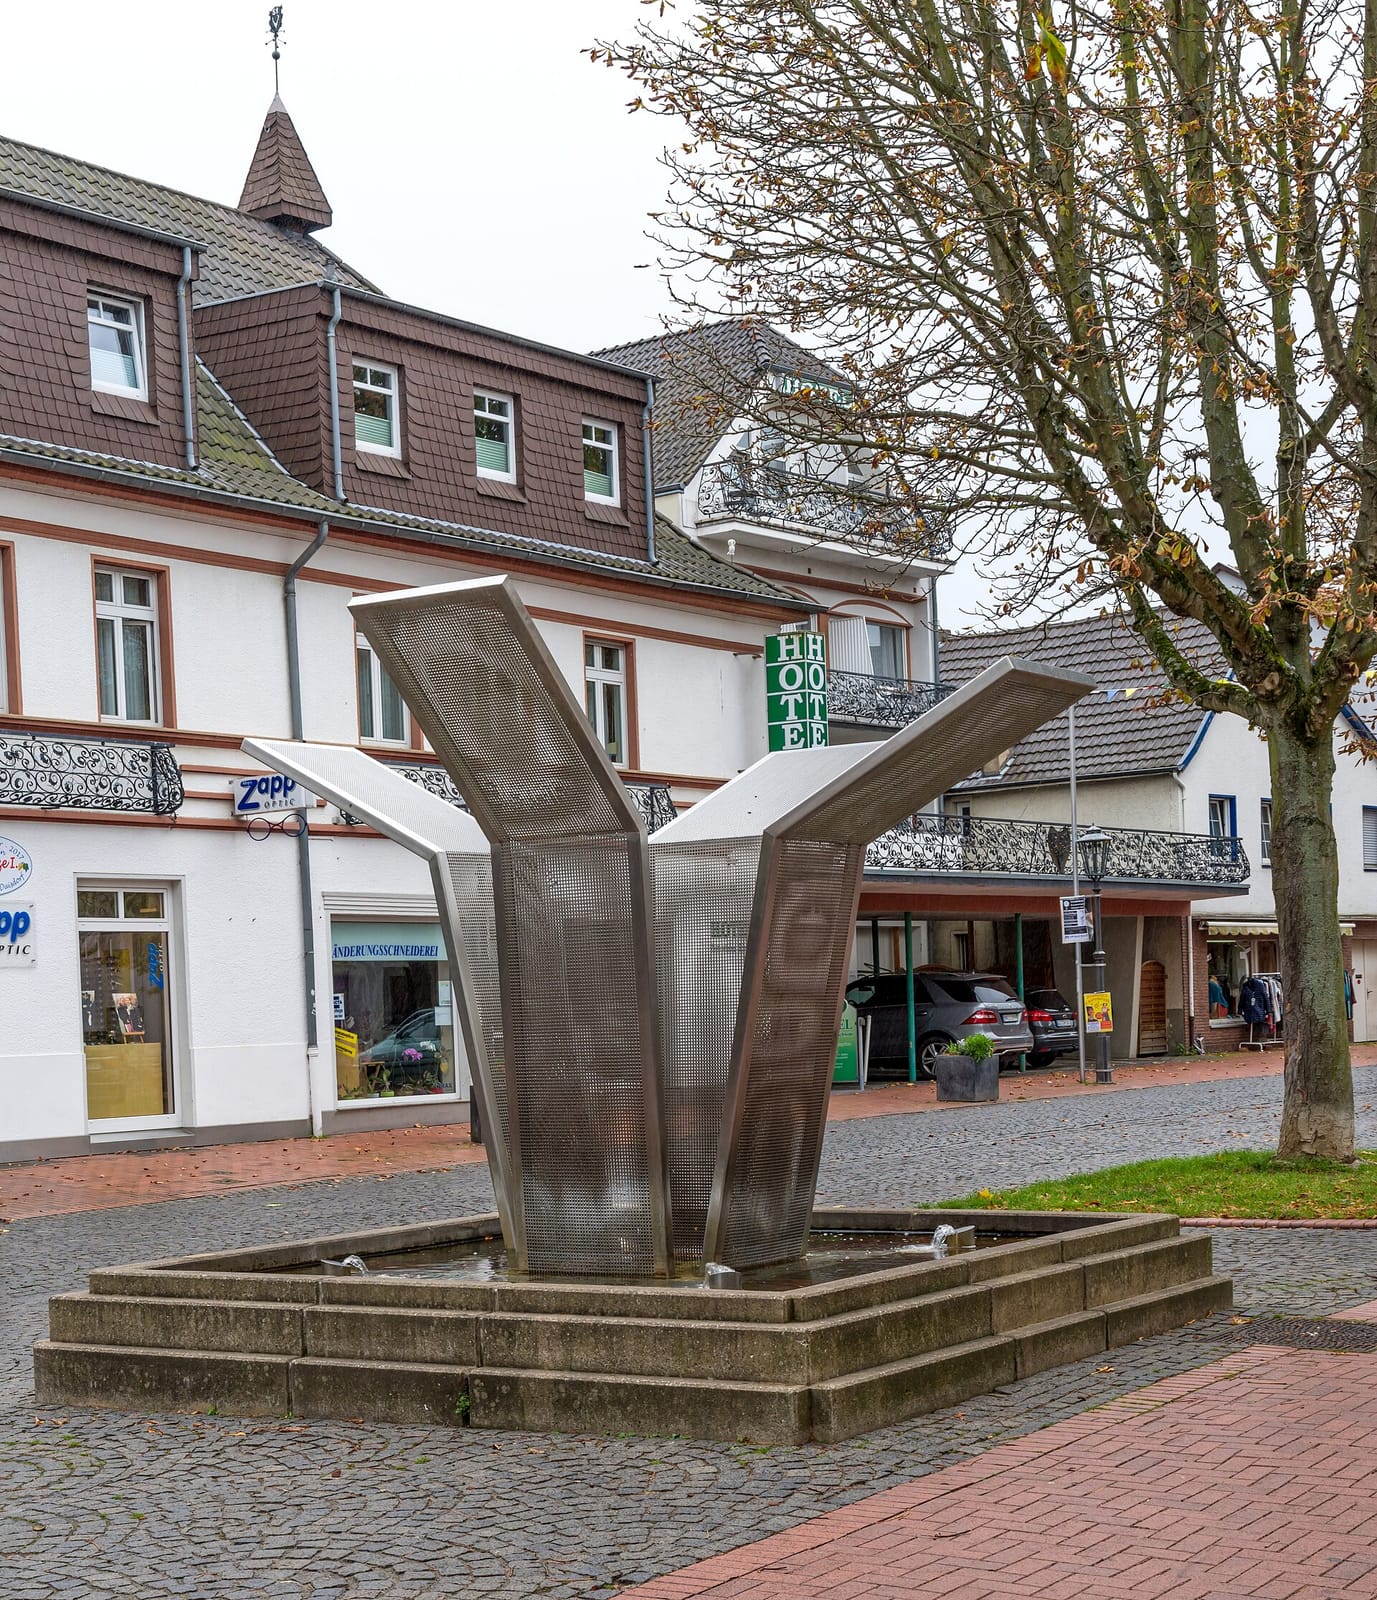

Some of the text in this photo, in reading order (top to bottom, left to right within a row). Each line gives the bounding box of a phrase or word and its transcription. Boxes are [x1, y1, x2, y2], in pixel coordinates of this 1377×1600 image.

[777, 634, 805, 750] HOTE
[807, 634, 826, 748] HOTE
[238, 775, 296, 810] Zapp
[264, 798, 295, 809] OPTIC
[332, 943, 439, 958] ÄNDERUNGSSCHNEIDEREI
